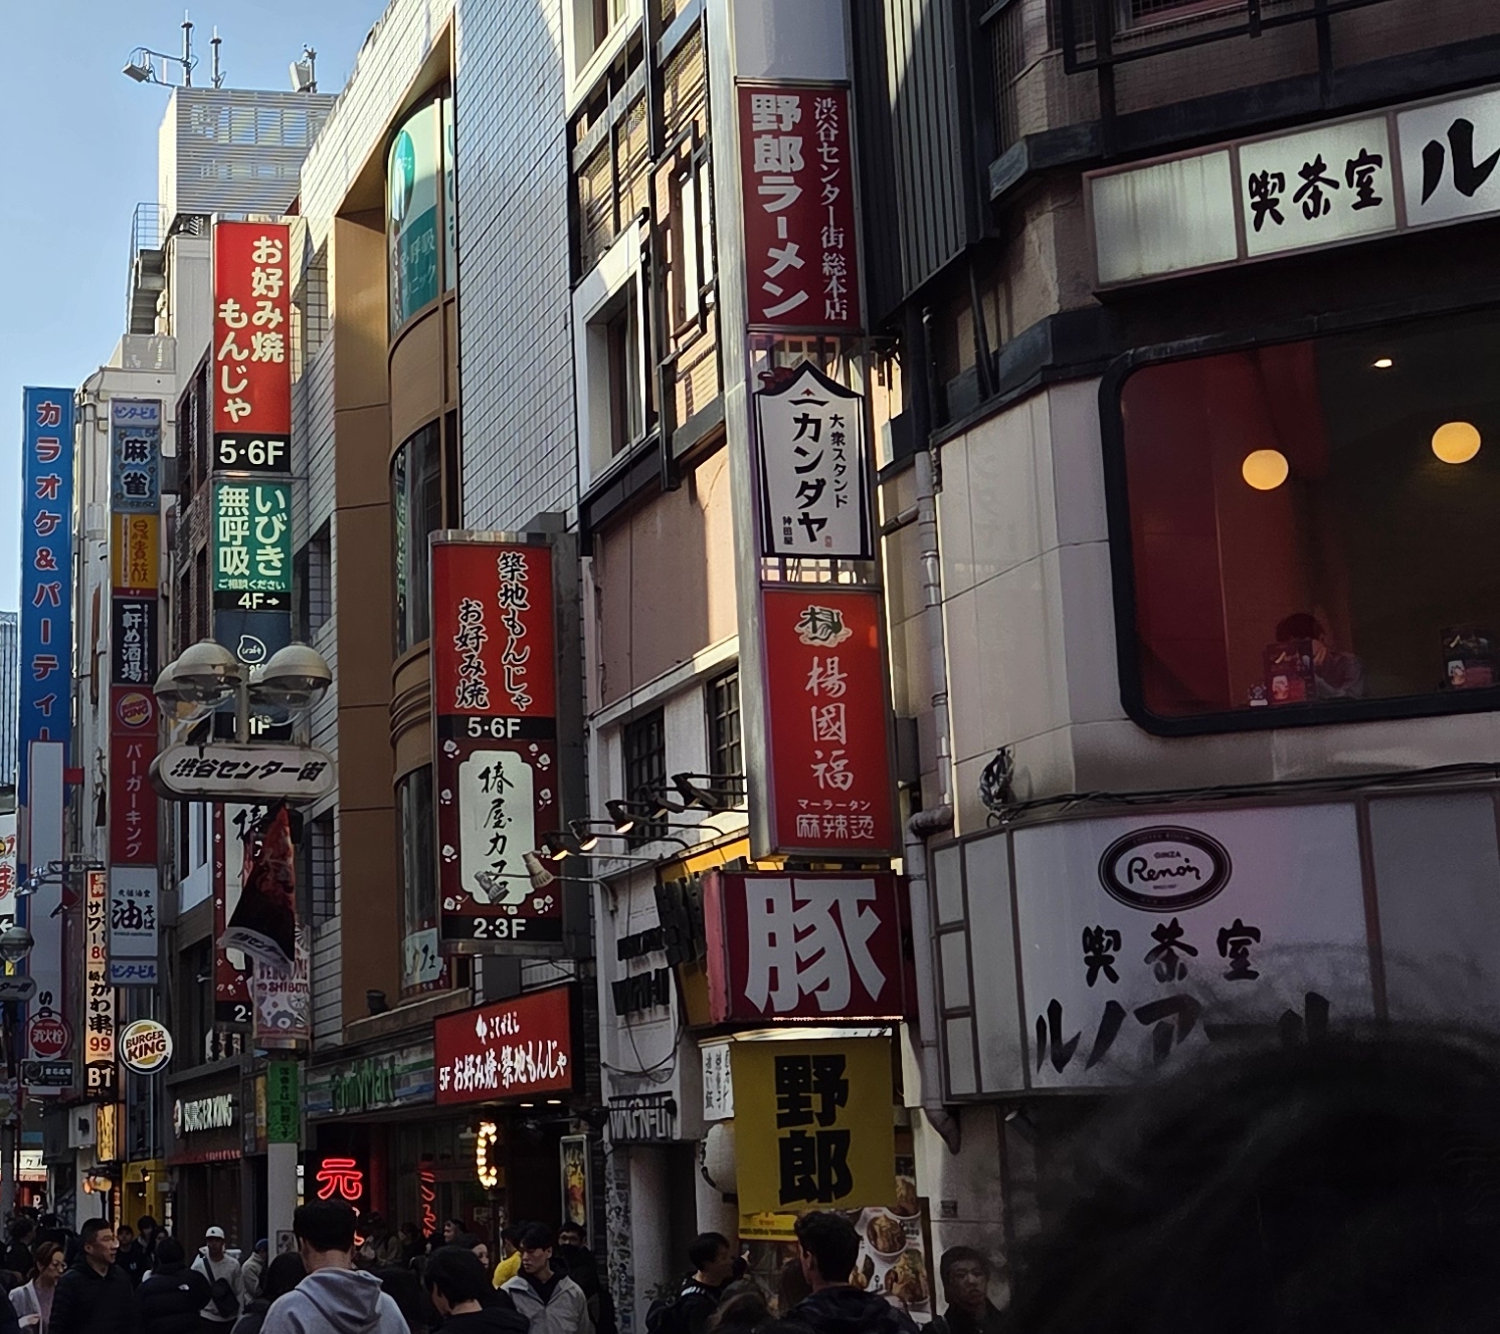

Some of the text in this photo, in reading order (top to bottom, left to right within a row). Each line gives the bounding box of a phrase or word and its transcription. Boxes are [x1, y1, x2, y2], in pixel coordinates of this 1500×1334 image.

[750, 93, 810, 319] 野郎ラーメン
[1248, 147, 1384, 233] 喫茶室
[251, 235, 286, 364] お好み焼
[216, 297, 252, 425] もんじゃ
[113, 406, 158, 421] センタービル
[122, 437, 151, 499] 麻雀
[791, 412, 829, 543] カンダヤ
[828, 413, 849, 509] 大衆スタンド
[217, 485, 251, 578] 無呼吸
[254, 485, 289, 577] いびき
[237, 593, 266, 610] 4F
[497, 551, 532, 713] 築地もんじゃ
[120, 603, 143, 683] 一軒め酒場
[454, 597, 490, 709] お好み焼
[804, 655, 855, 792] 楊國福
[124, 743, 143, 858] バーガーキング
[174, 757, 328, 784] 渋谷センター街
[797, 799, 871, 812] マーラータン
[1127, 855, 1202, 885] Renoir
[111, 963, 158, 980] センタービル
[743, 877, 887, 1014] 豚
[1081, 916, 1262, 988] 喫茶室
[32, 1028, 64, 1045] 消火栓
[89, 1036, 111, 1052] 99
[125, 1030, 165, 1049] BURGER
[126, 1039, 167, 1062] KING
[438, 1066, 452, 1092] 5F
[774, 1053, 853, 1205] 野郎
[315, 1157, 364, 1201] 元
